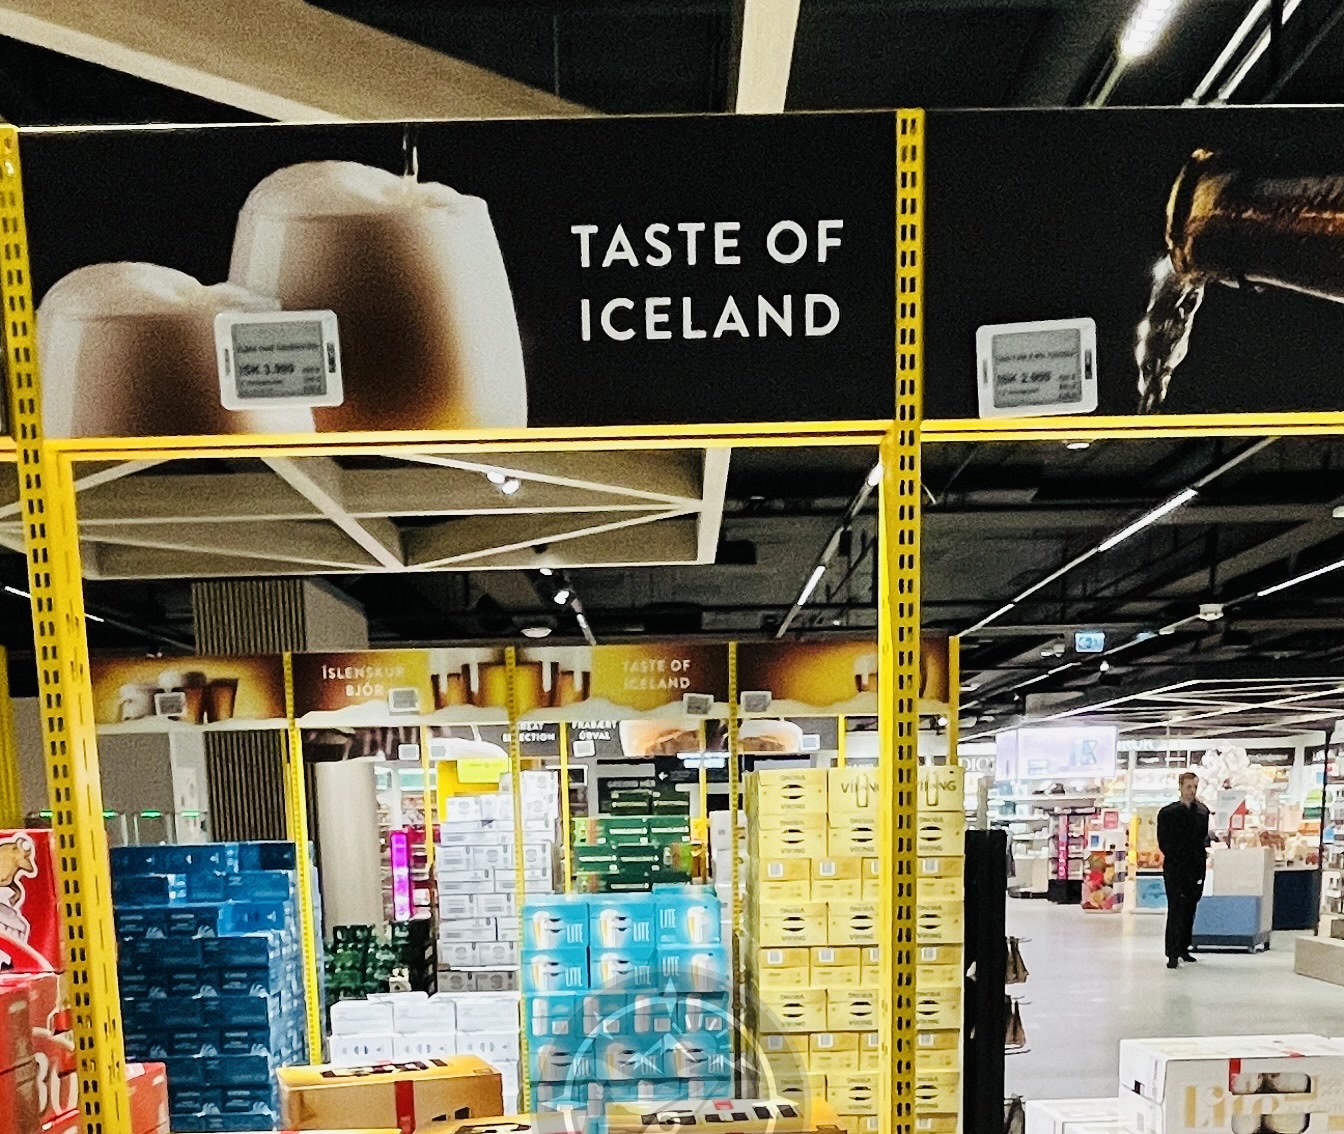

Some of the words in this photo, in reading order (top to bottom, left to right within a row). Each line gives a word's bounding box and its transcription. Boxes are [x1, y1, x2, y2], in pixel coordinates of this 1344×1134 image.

[570, 222, 741, 268] TASTE
[766, 219, 844, 265] OF
[580, 293, 840, 341] ICELAND
[321, 664, 406, 680] ÍSLENSKUR
[622, 660, 664, 674] TASTE
[670, 659, 691, 673] OF
[345, 681, 385, 698] BJÓR
[623, 676, 691, 691] ICELAND
[659, 908, 676, 929] LITE
[633, 921, 650, 942] LITE
